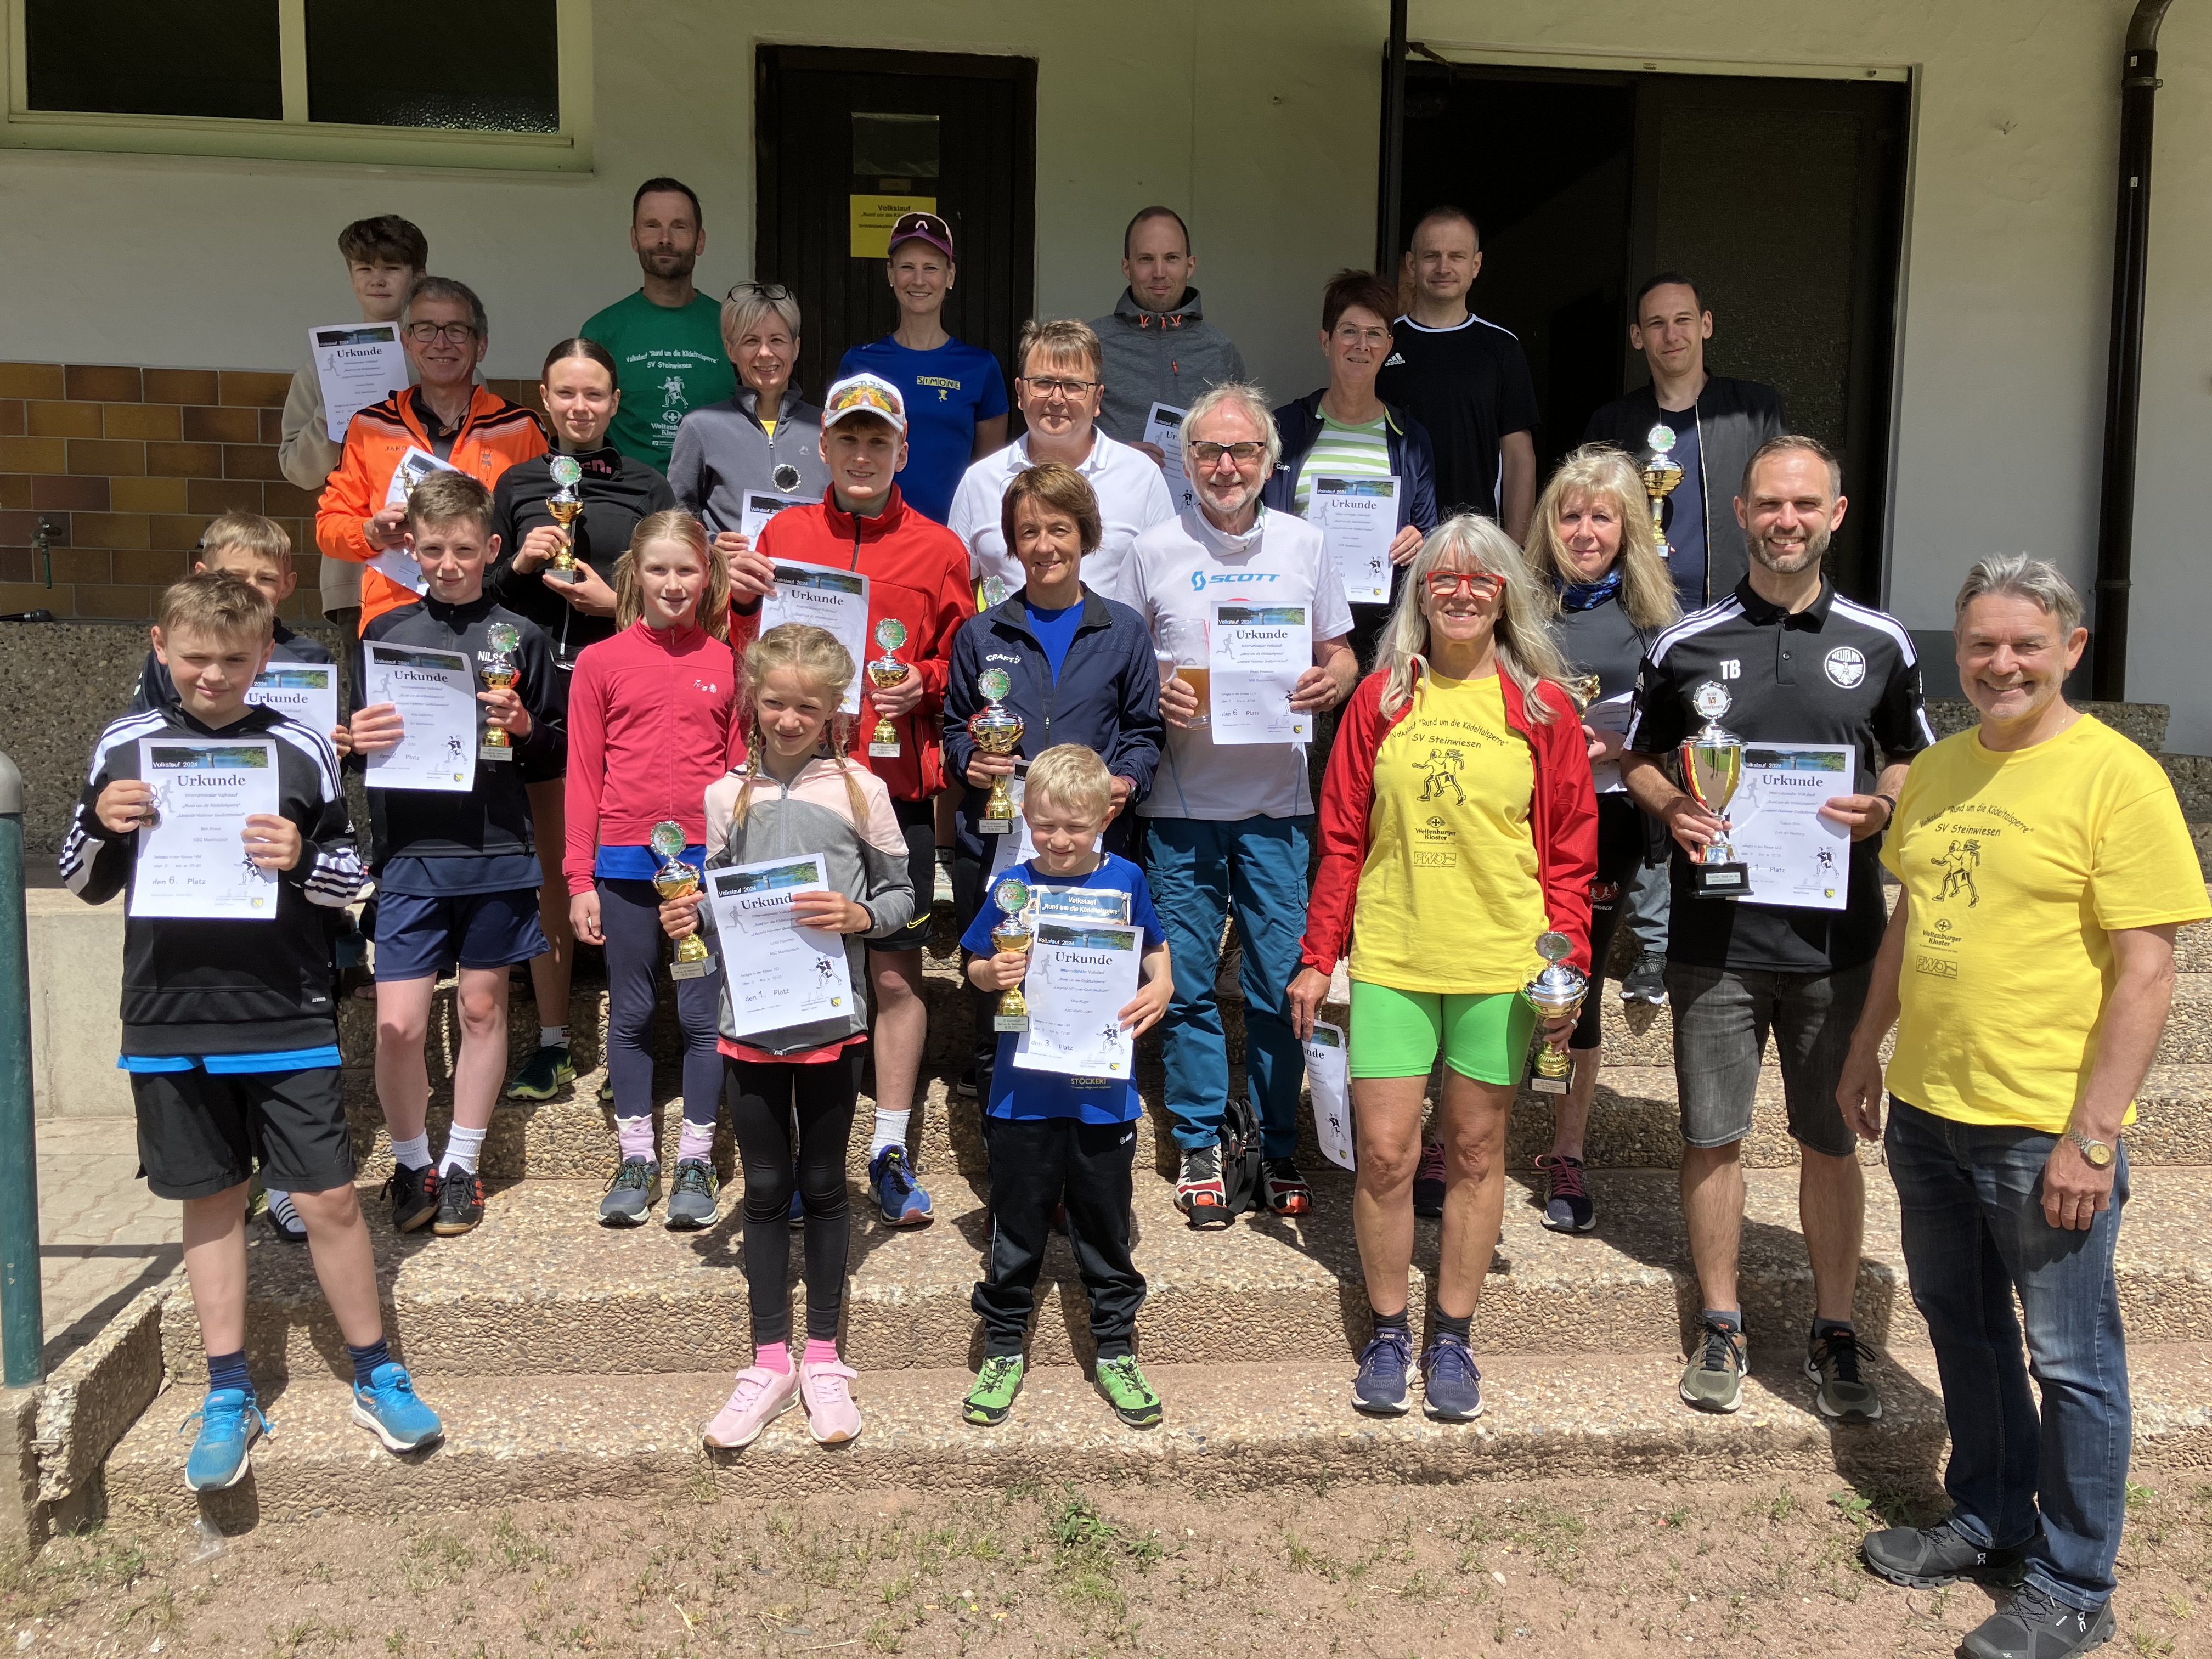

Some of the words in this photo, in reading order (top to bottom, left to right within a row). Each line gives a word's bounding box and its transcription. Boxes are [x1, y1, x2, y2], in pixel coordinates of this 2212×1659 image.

[337, 347, 382, 358] Urkunde
[626, 352, 647, 363] Volkslauf
[917, 377, 960, 388] SIMONE
[1332, 499, 1376, 509] Urkunde
[1208, 573, 1280, 584] SCOTT
[792, 590, 844, 606] Urkunde
[1235, 630, 1288, 639] Urkunde
[986, 653, 1015, 663] CRAFT
[1831, 650, 1861, 662] NEUFANG
[1720, 659, 1741, 680] TB
[394, 670, 449, 682] Urkunde
[248, 693, 308, 703] Urkunde
[1392, 722, 1417, 738] Volkslauf
[1419, 718, 1437, 727] "Rund
[1451, 719, 1460, 727] die
[1463, 720, 1509, 746] Ködeltalsperre"
[1412, 733, 1425, 742] SV
[1429, 736, 1481, 748] Steinwiesen
[177, 774, 246, 787] Urkunde
[1763, 774, 1824, 788] Urkunde
[1920, 809, 1944, 828] Volkslauf
[1948, 803, 1965, 814] "Rund
[1977, 803, 1987, 813] die
[1987, 805, 2034, 834] Ködeltalsperre"
[1936, 823, 1949, 833] SV
[1951, 824, 2001, 837] Steinwiesen
[1413, 851, 1446, 865] FWO
[169, 876, 178, 884] 6.
[719, 888, 742, 897] Volkslauf
[741, 892, 797, 910] Urkund
[1042, 901, 1058, 911] „Rund
[1069, 896, 1097, 905] Volkslauf
[1922, 930, 1962, 943] Weltenburger
[1928, 938, 1951, 947] Kloster
[1056, 951, 1113, 966] Urkunde
[758, 990, 766, 998] 1.
[1304, 1048, 1324, 1059] unde
[1071, 1076, 1107, 1085] STÖCKERT
